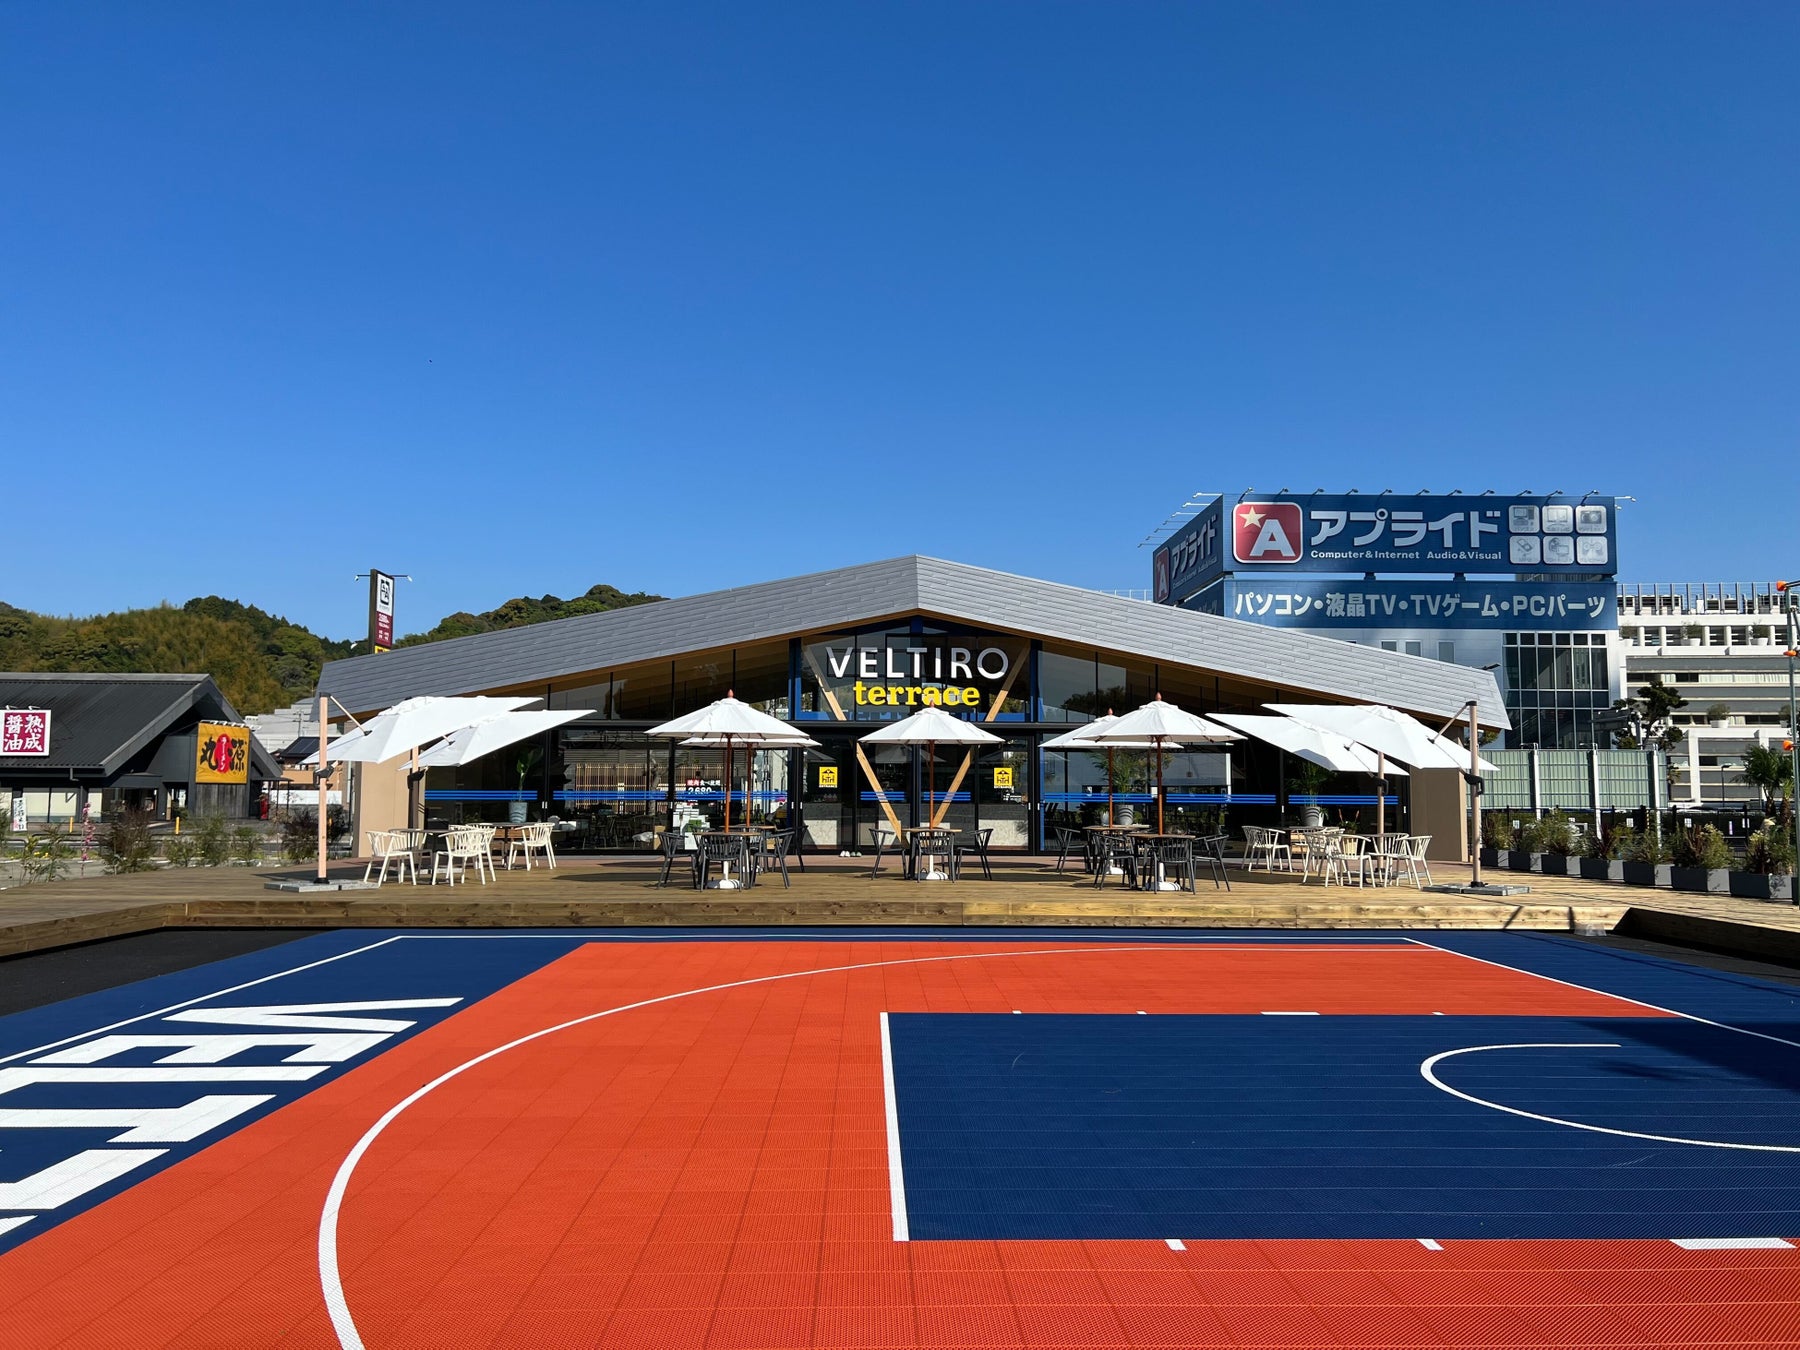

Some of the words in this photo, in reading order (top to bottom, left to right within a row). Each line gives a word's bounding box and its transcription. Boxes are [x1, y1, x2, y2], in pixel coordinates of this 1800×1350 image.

[1249, 519, 1296, 556] A
[1310, 507, 1500, 548] アプライド
[1171, 514, 1217, 580] アプライド
[826, 646, 1010, 680] VELTIRO
[853, 681, 981, 707] terrace
